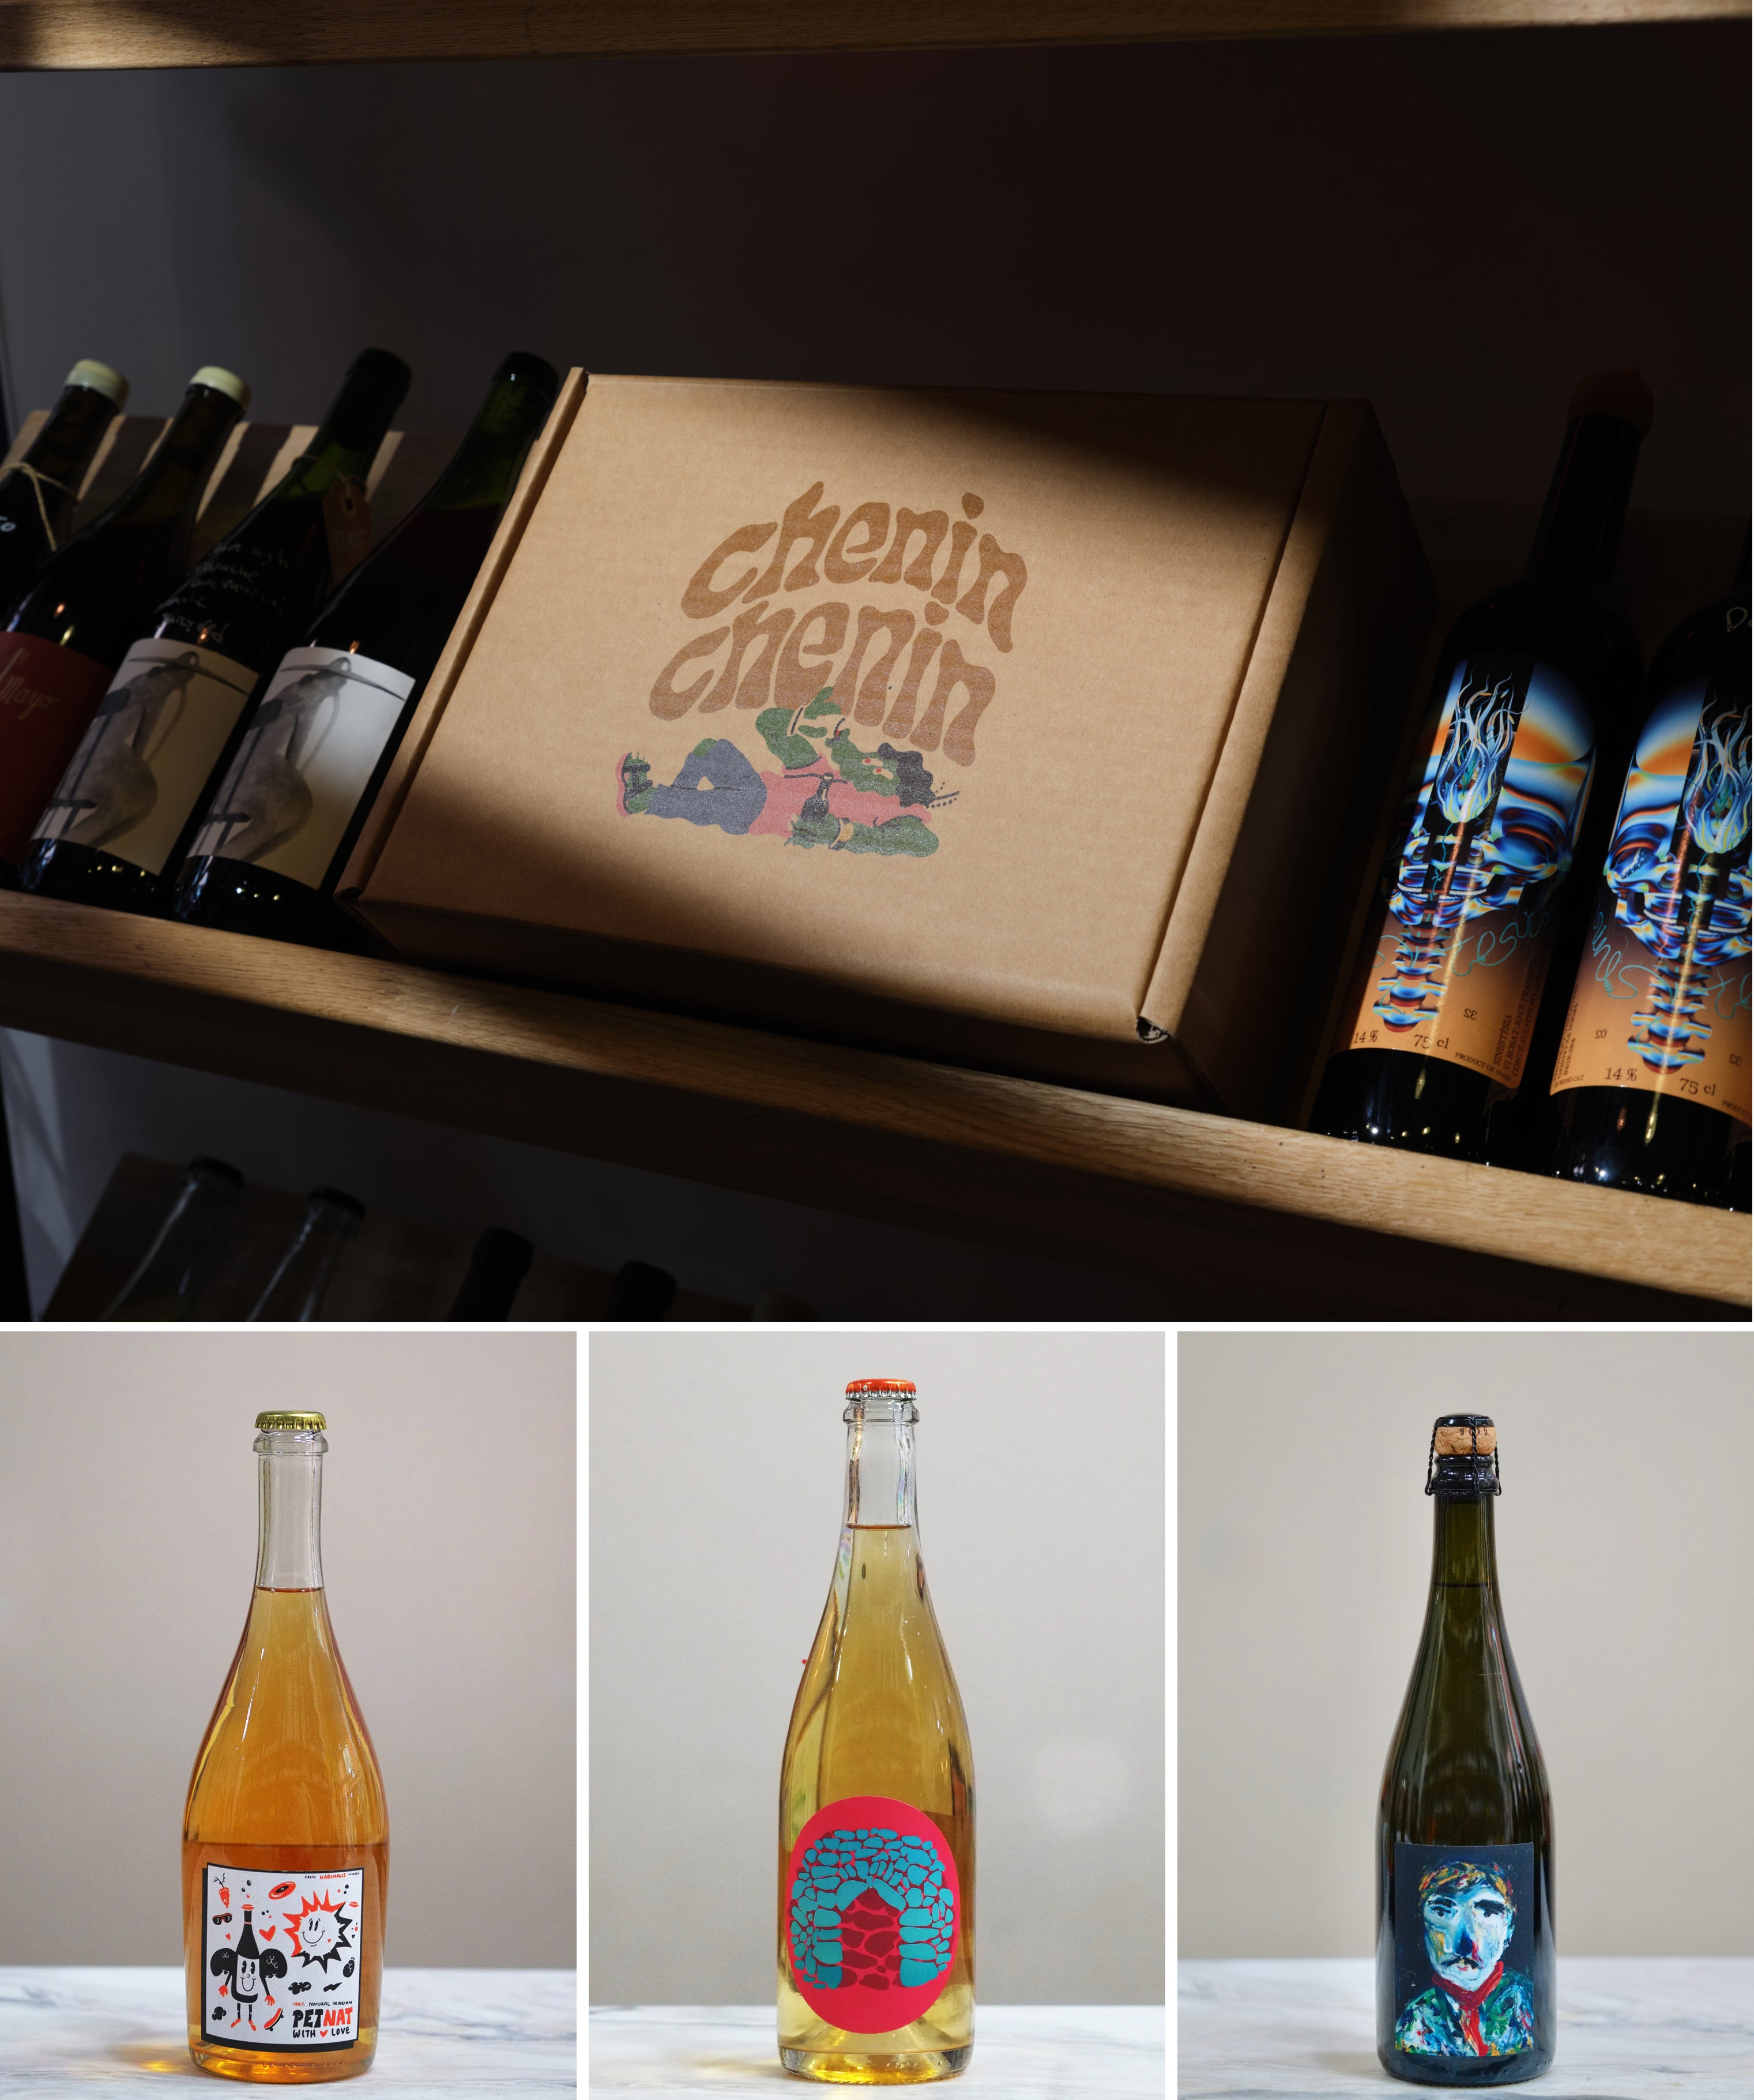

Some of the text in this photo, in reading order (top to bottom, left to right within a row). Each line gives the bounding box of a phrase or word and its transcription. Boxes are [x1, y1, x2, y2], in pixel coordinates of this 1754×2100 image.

[681, 481, 1028, 653] chenin
[649, 600, 996, 767] chenin
[1515, 1003, 1526, 1028] JOVE
[1352, 1030, 1367, 1044] 14
[1414, 1034, 1450, 1049] 75 cl
[1506, 1028, 1520, 1059] ROSAT
[1455, 1052, 1486, 1068] PRODUCT
[1486, 1064, 1495, 1072] OF
[1503, 1059, 1512, 1070] VI
[1604, 1067, 1623, 1080] 14
[1680, 1077, 1717, 1097] 75 cl
[292, 2026, 350, 2039] WITH LOVE
